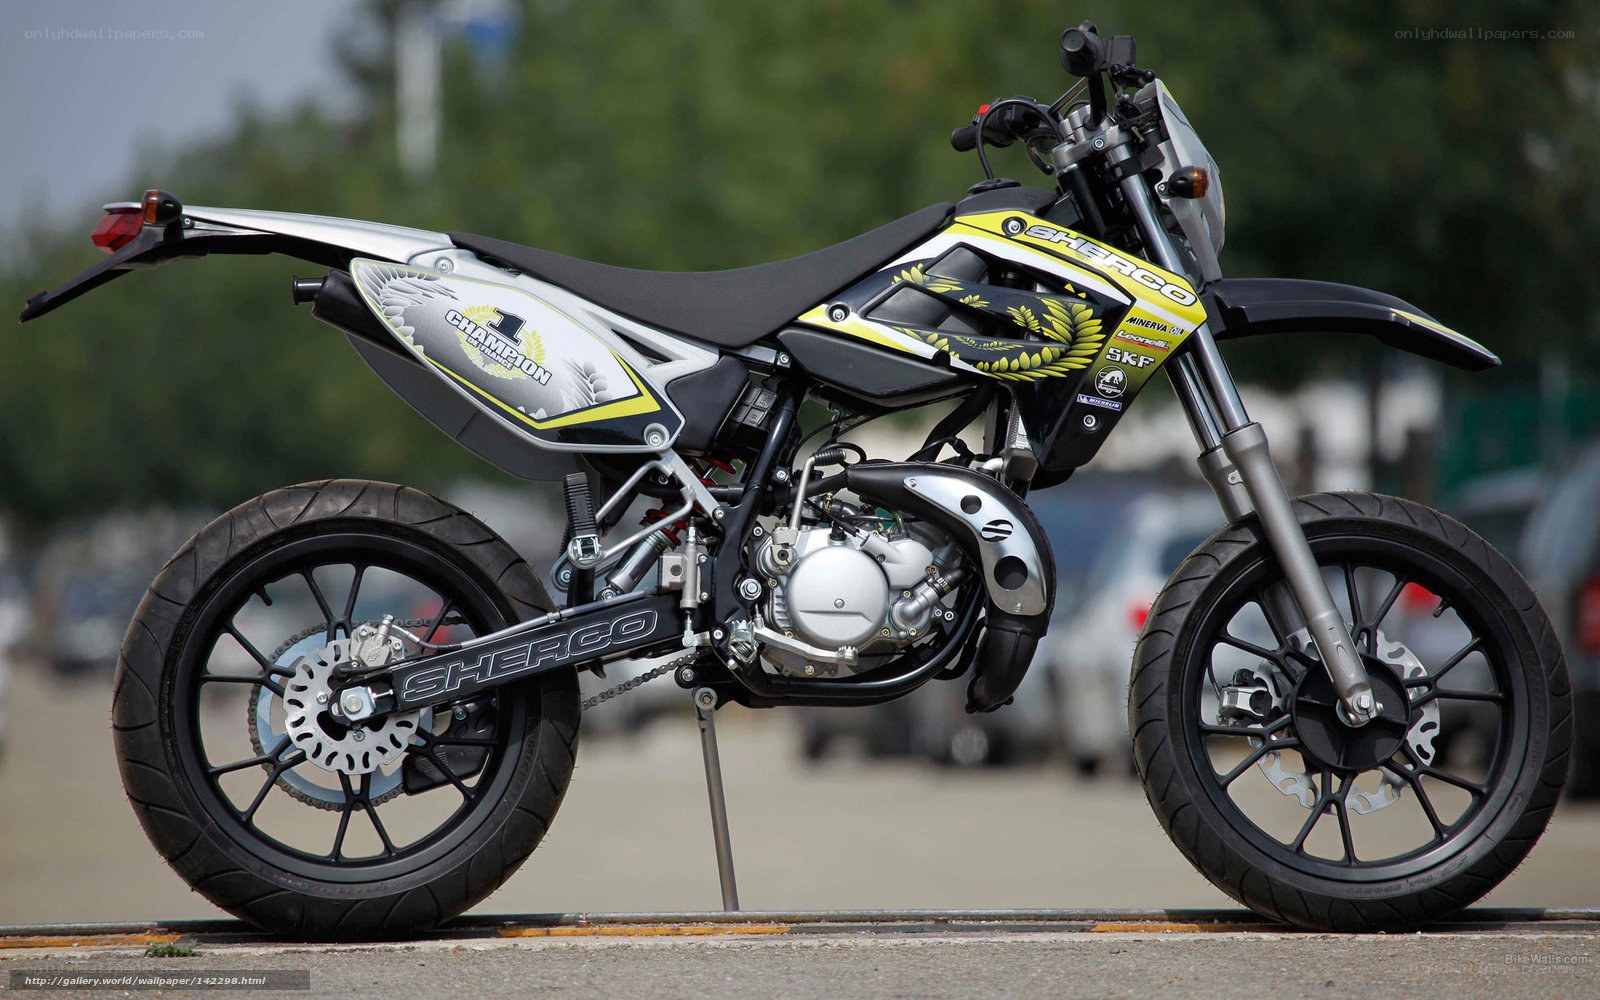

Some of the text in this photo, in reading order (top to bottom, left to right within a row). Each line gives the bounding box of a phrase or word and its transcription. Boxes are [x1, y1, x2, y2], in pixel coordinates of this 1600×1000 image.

[1024, 225, 1198, 307] SHERCO
[486, 307, 526, 346] 1
[1126, 316, 1168, 332] MINERVA
[466, 335, 513, 370] DE FRANCE
[1105, 347, 1155, 368] SKF
[402, 610, 658, 702] SHERCO
